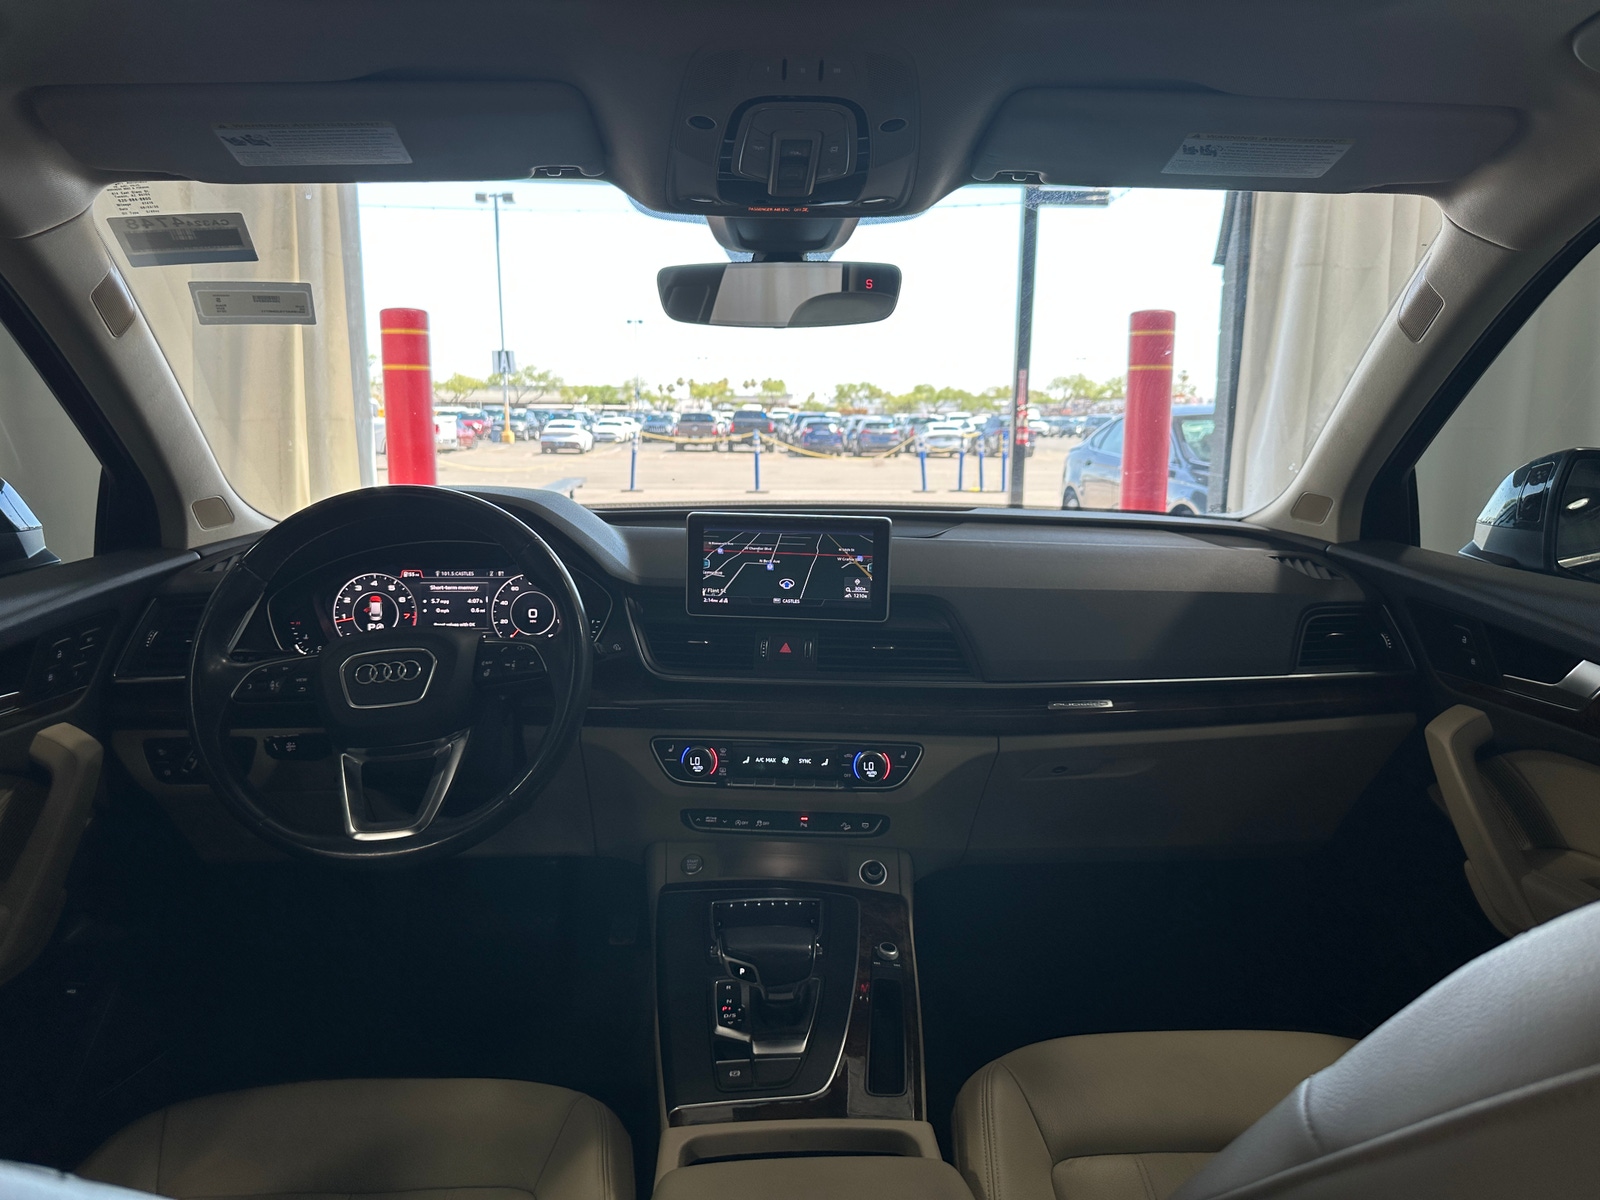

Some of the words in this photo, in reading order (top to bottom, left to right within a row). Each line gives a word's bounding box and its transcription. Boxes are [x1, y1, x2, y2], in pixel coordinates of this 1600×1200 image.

[865, 279, 873, 289] S
[528, 608, 538, 619] 0
[690, 757, 700, 766] LO
[864, 762, 874, 770] LO
